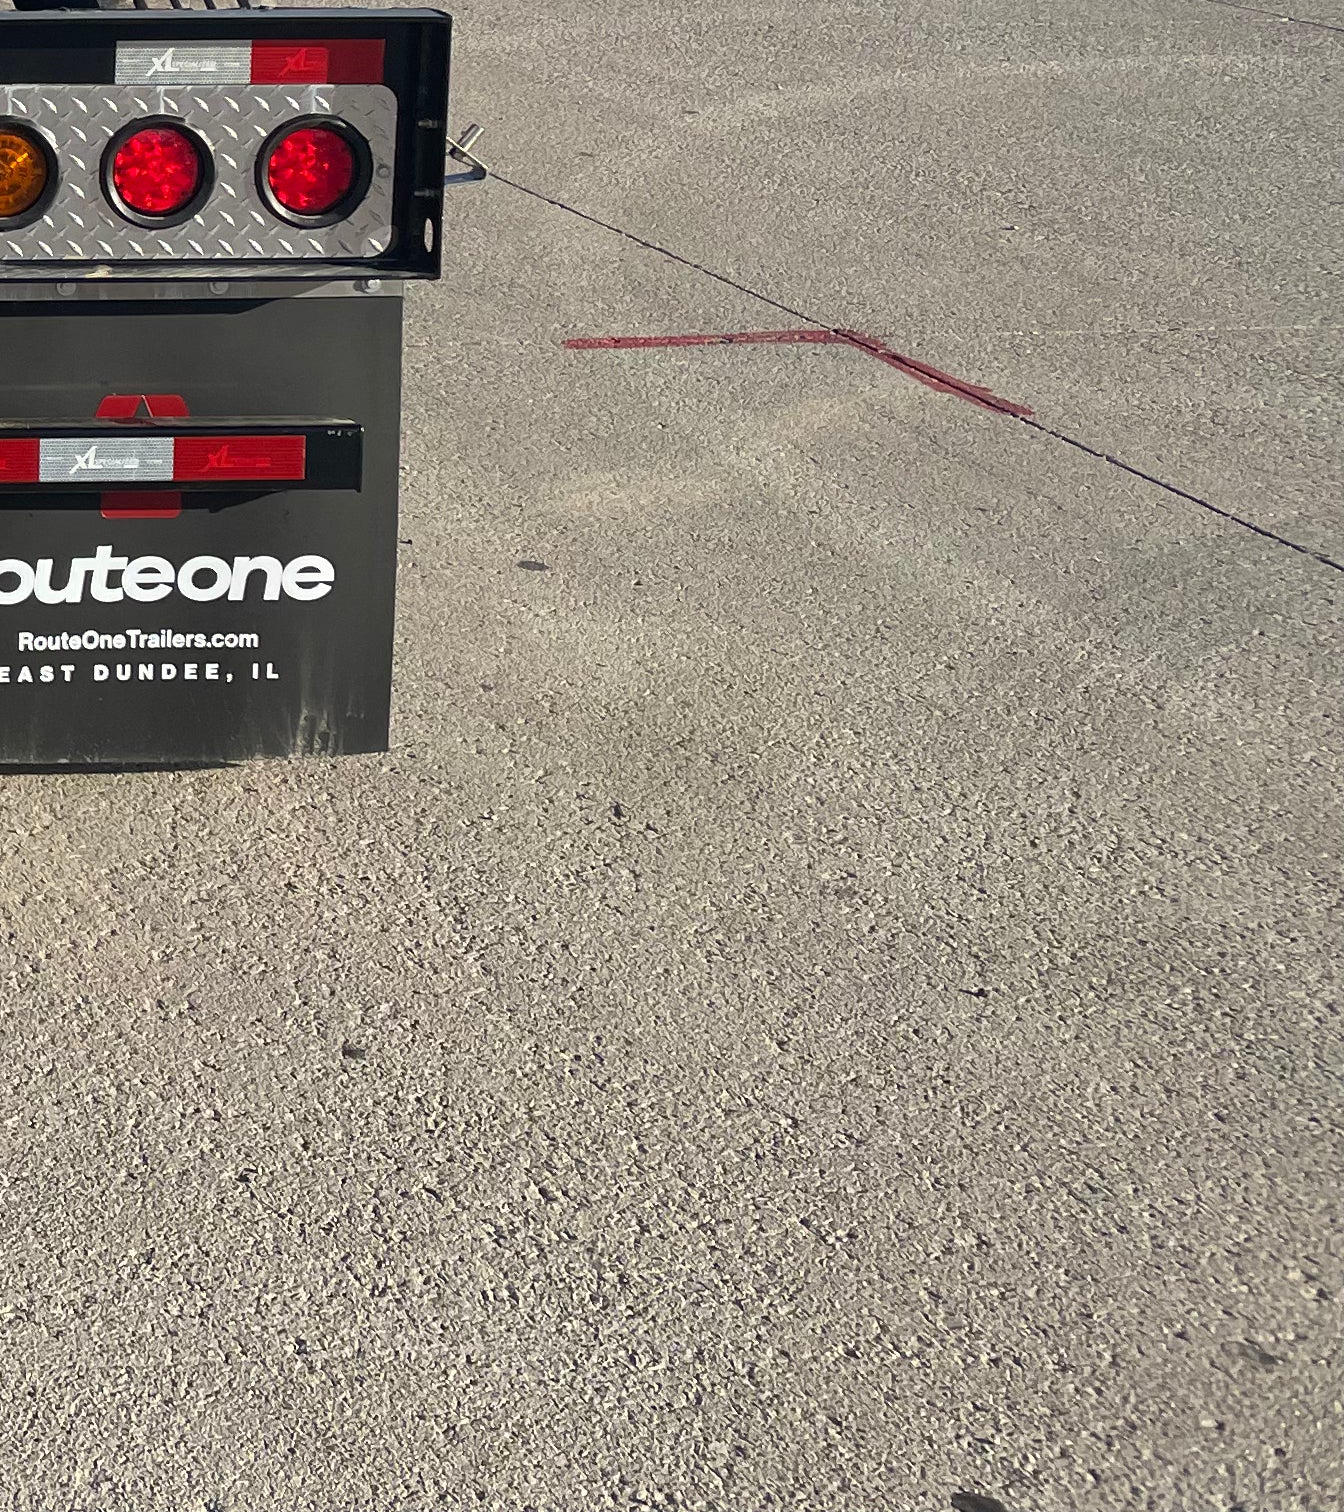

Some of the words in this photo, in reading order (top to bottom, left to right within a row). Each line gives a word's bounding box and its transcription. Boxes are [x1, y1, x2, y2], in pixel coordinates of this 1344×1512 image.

[146, 47, 180, 76] XL
[69, 445, 103, 474] XL
[18, 628, 259, 652] RouteOneTrailers.com
[93, 663, 235, 683] DUNDEE,
[252, 662, 280, 680] IL
